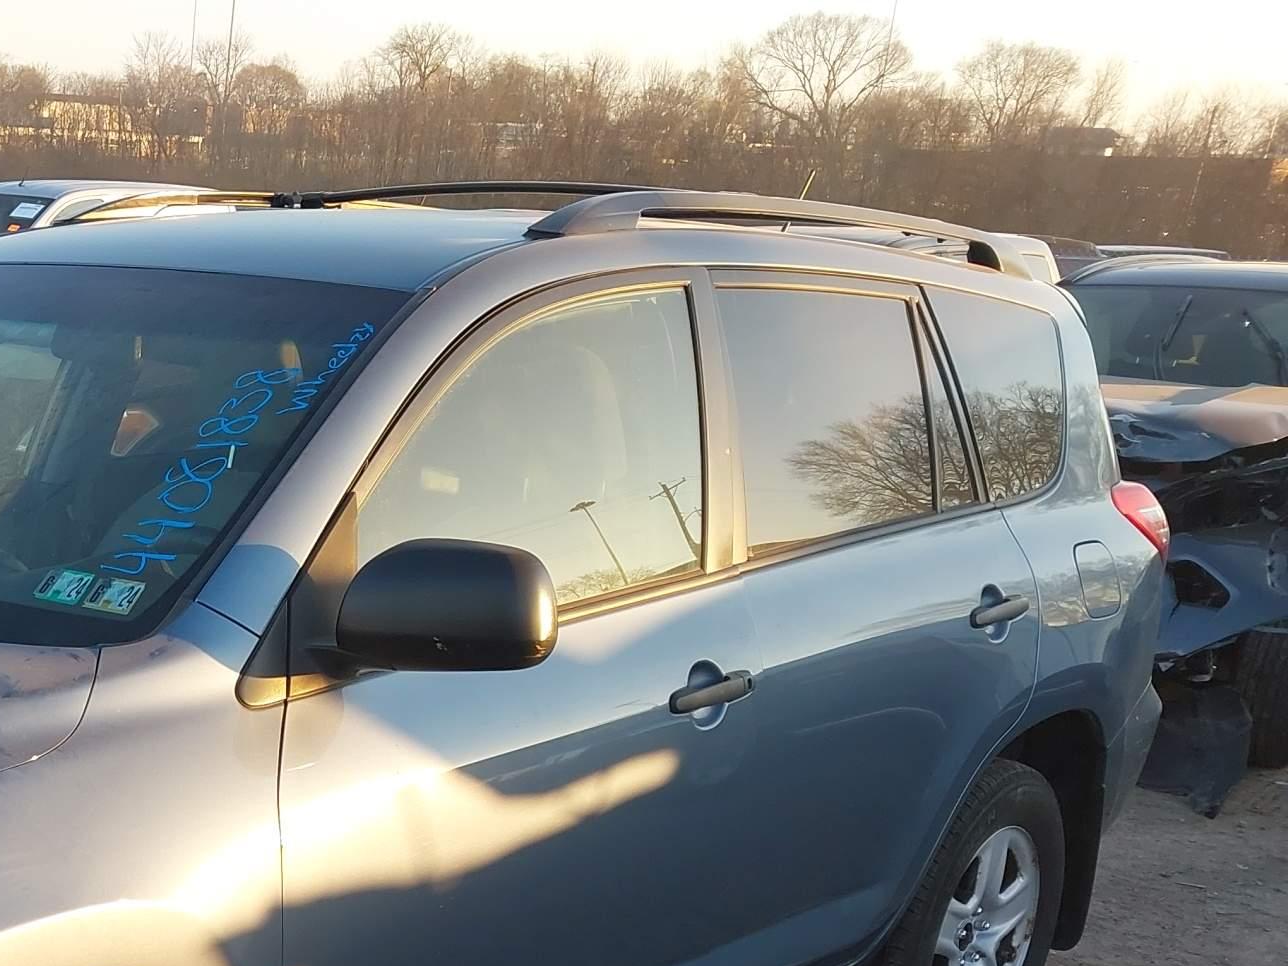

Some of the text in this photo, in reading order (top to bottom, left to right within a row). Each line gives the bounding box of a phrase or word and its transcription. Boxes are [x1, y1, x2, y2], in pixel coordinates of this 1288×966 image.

[100, 367, 304, 576] 44081838
[39, 575, 91, 600] 6 24
[90, 584, 141, 609] 6 24
